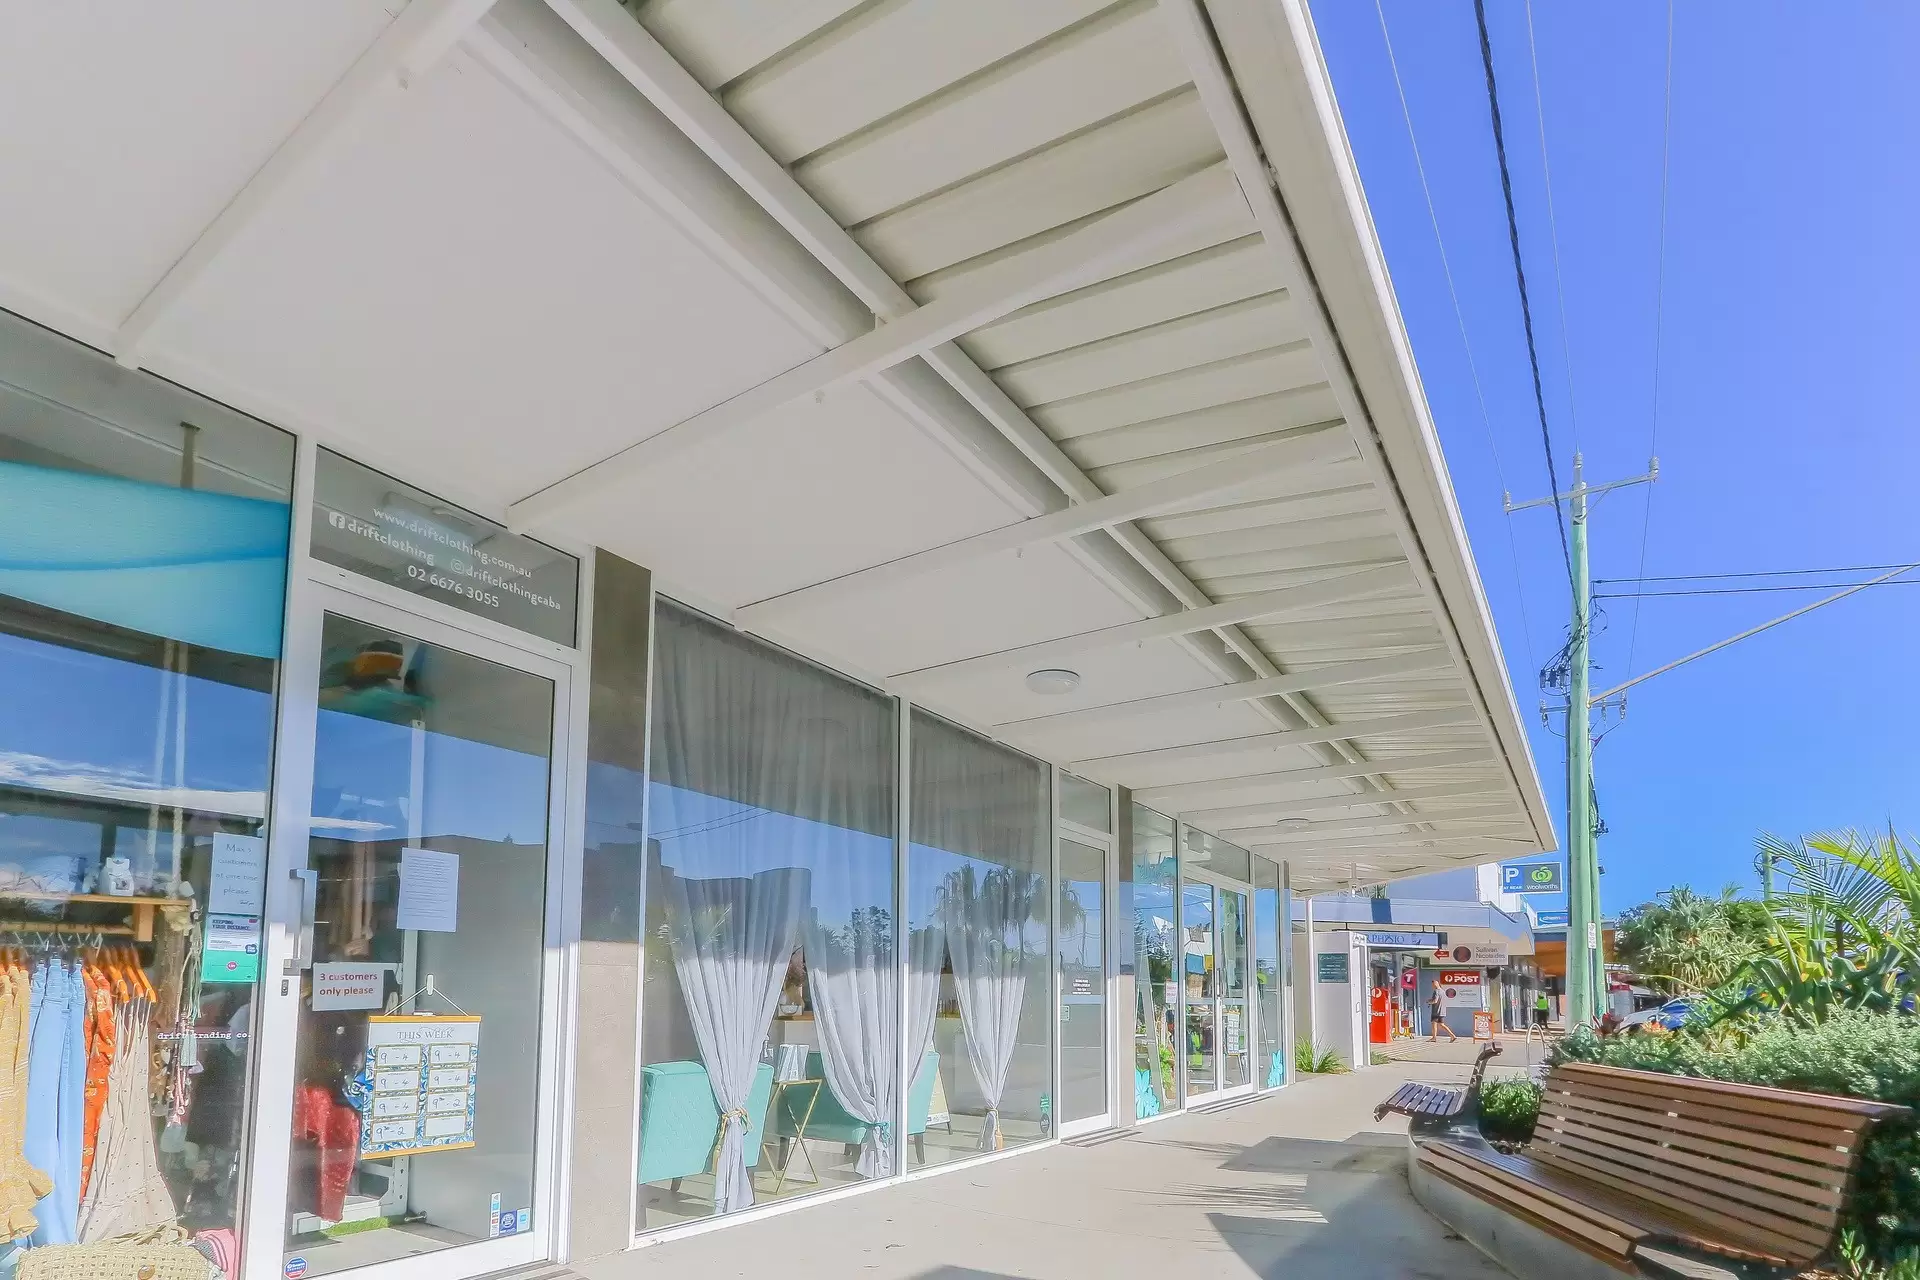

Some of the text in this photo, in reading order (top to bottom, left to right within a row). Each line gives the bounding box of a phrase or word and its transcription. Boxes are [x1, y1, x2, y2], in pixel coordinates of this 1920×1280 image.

[347, 516, 435, 566] driftclothing
[373, 507, 532, 578] www.driftclothing.com.au
[407, 565, 500, 608] 02 6676 3055
[1505, 867, 1519, 883] P
[320, 973, 378, 981] 3 customers
[1454, 975, 1479, 983] POST
[320, 986, 374, 996] only please
[193, 1032, 232, 1040] trading
[397, 1029, 454, 1040] THIS WEEK
